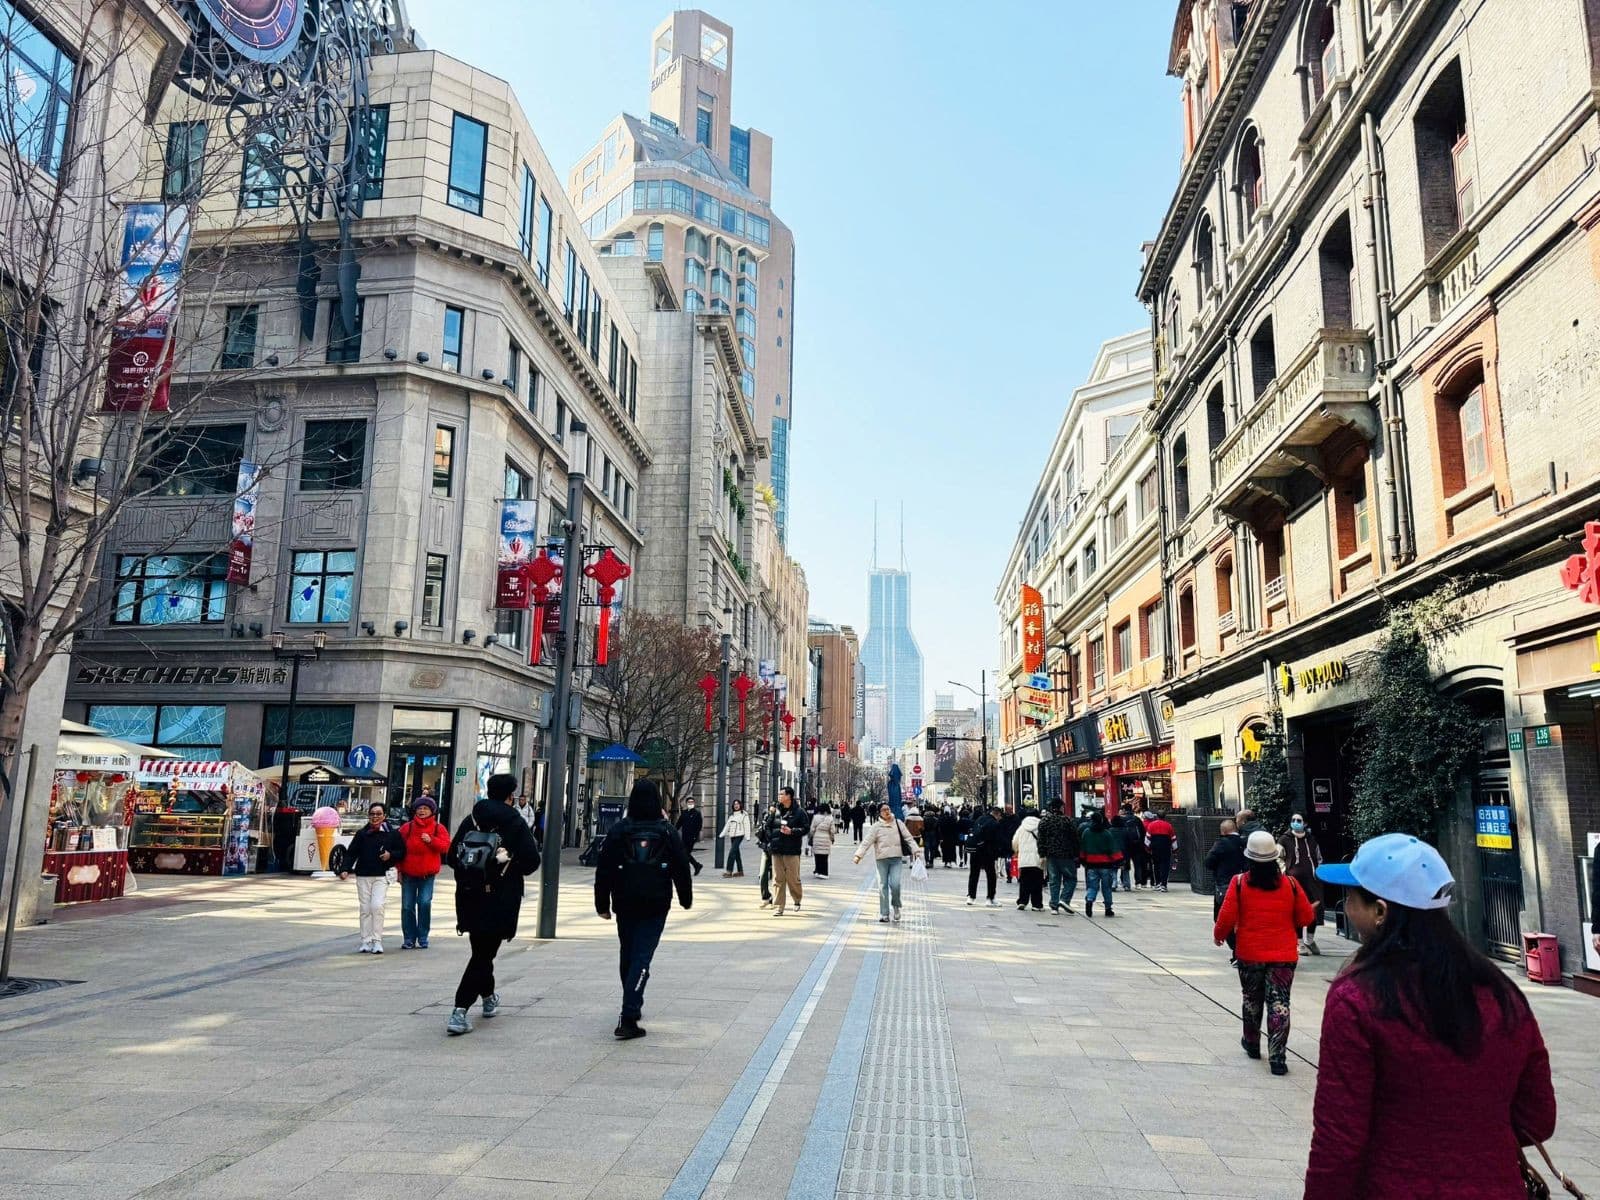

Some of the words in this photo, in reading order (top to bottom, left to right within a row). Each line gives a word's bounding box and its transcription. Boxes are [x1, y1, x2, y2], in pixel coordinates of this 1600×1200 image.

[74, 666, 241, 684] SKECHERS
[240, 667, 288, 684] 斯凯奇
[856, 682, 864, 719] HUAWEI
